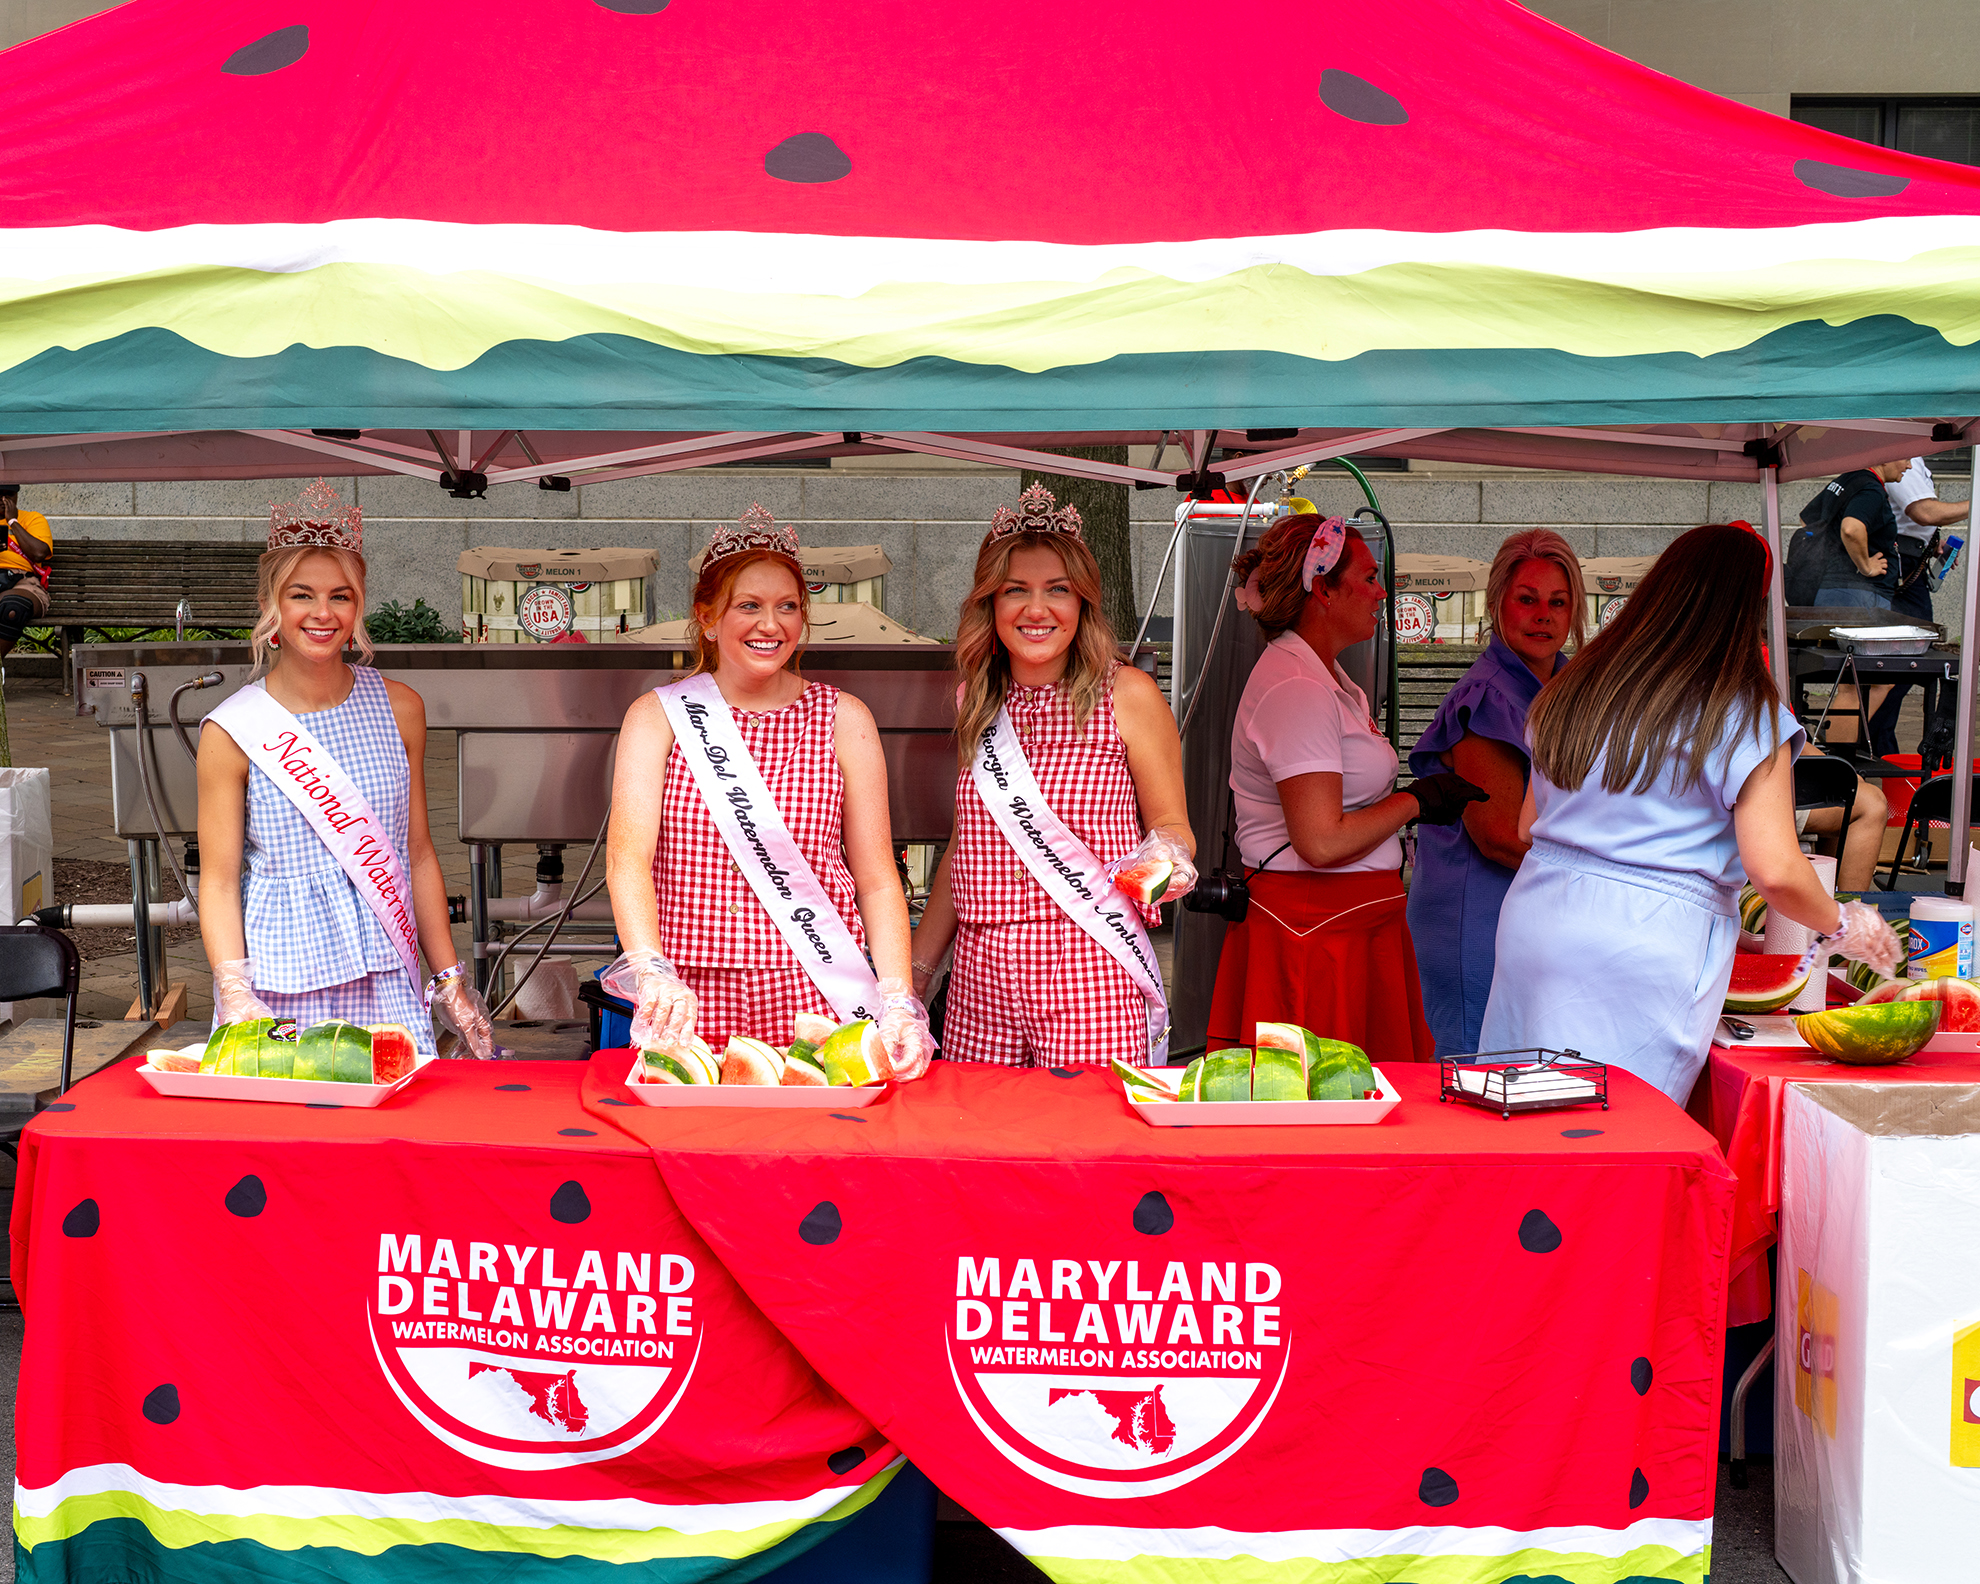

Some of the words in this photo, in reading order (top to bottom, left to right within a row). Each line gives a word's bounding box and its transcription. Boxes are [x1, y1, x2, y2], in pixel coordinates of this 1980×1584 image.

[545, 568, 575, 576] MELON
[802, 568, 818, 576] LON
[1415, 578, 1444, 586] MELON
[533, 610, 559, 623] USA
[1395, 618, 1421, 631] USA
[981, 724, 1009, 791] Georgia
[1008, 796, 1093, 900] Watermelon
[263, 731, 368, 835] National
[353, 834, 419, 969] Watermelon
[725, 786, 792, 900] Watermelon
[790, 907, 832, 964] Queen
[378, 1233, 695, 1294] MARYLAND
[956, 1256, 1282, 1302] MARYLAND
[378, 1275, 693, 1336] DELAWARE
[956, 1299, 1281, 1346] DELAWARE
[392, 1321, 528, 1350] WATERMELON
[535, 1334, 674, 1359] ASSOCIATION
[970, 1346, 1114, 1368] WATERMELON
[1121, 1350, 1261, 1370] ASSOCIATION
